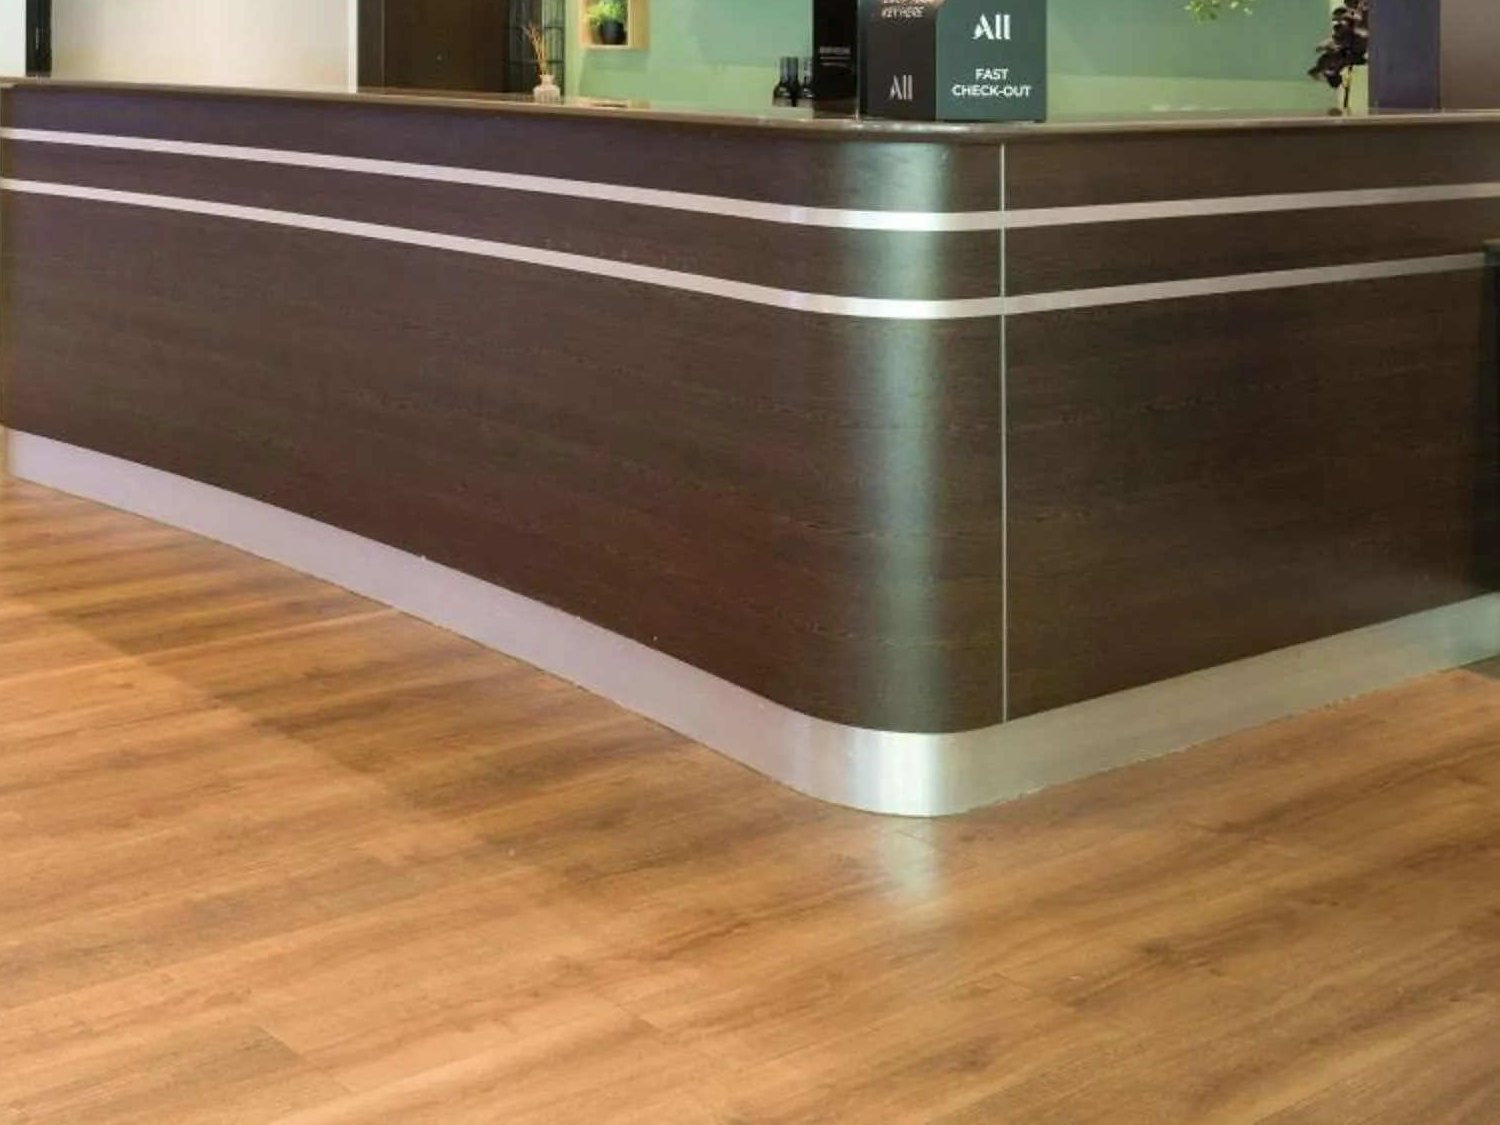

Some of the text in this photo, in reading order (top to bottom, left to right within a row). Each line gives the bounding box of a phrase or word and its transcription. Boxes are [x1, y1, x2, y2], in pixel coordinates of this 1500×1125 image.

[972, 13, 1012, 40] All
[975, 68, 1009, 80] FAST
[887, 74, 913, 101] All
[951, 84, 1032, 97] CHECK-OUT
